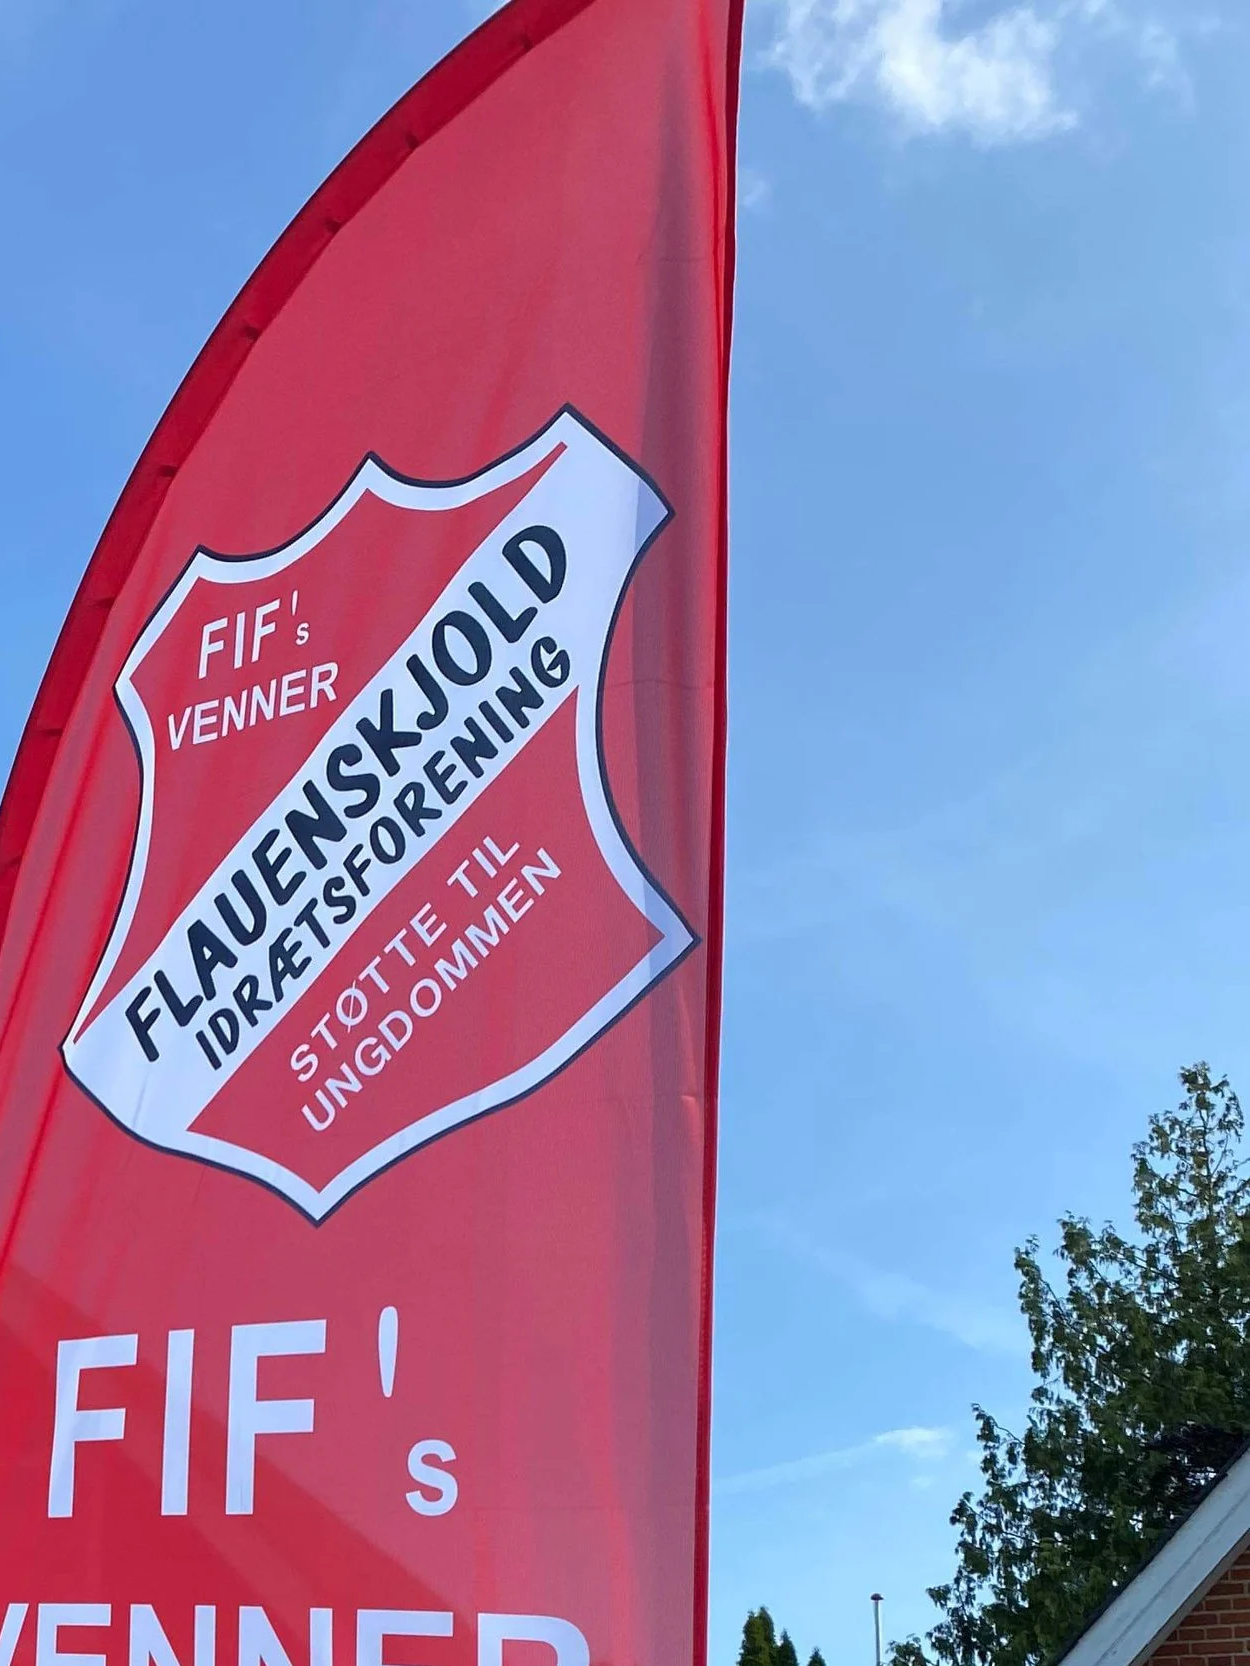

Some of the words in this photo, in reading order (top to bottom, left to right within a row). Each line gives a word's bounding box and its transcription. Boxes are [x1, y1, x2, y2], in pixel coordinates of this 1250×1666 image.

[124, 523, 568, 1063] FLAUENSKJOLD
[167, 661, 339, 751] VENNER
[195, 635, 571, 1071] IDRÆTSFORENING
[291, 903, 445, 1082] STØTTE
[447, 833, 520, 897] TIL
[302, 848, 562, 1132] UNGDOMMEN
